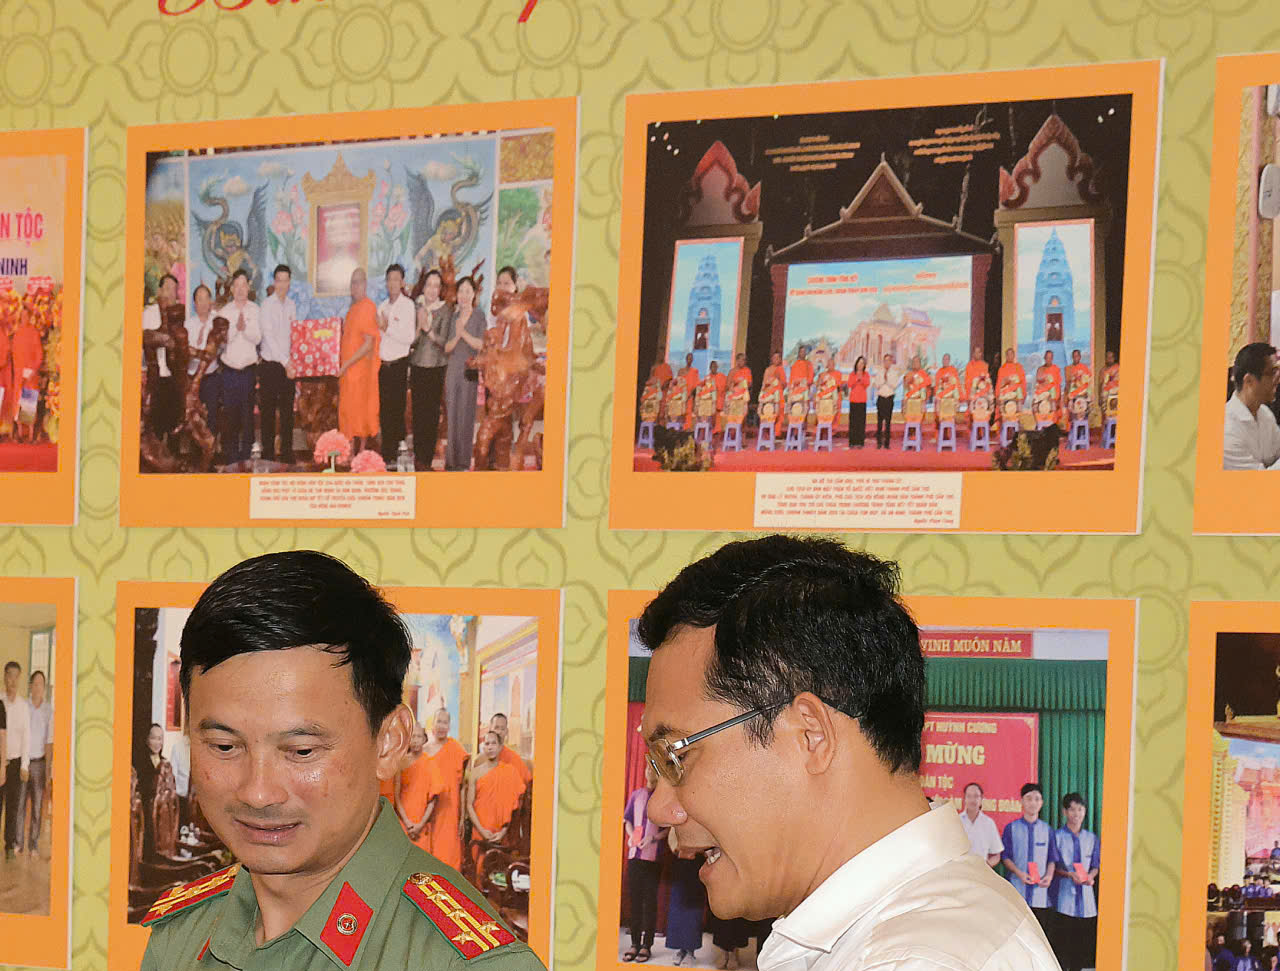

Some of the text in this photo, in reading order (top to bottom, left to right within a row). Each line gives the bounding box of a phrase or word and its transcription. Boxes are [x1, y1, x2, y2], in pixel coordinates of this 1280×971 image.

[16, 207, 44, 247] TỘC
[953, 636, 990, 653] MUÔN
[992, 637, 1022, 654] NĂM
[925, 741, 986, 765] MỪNG
